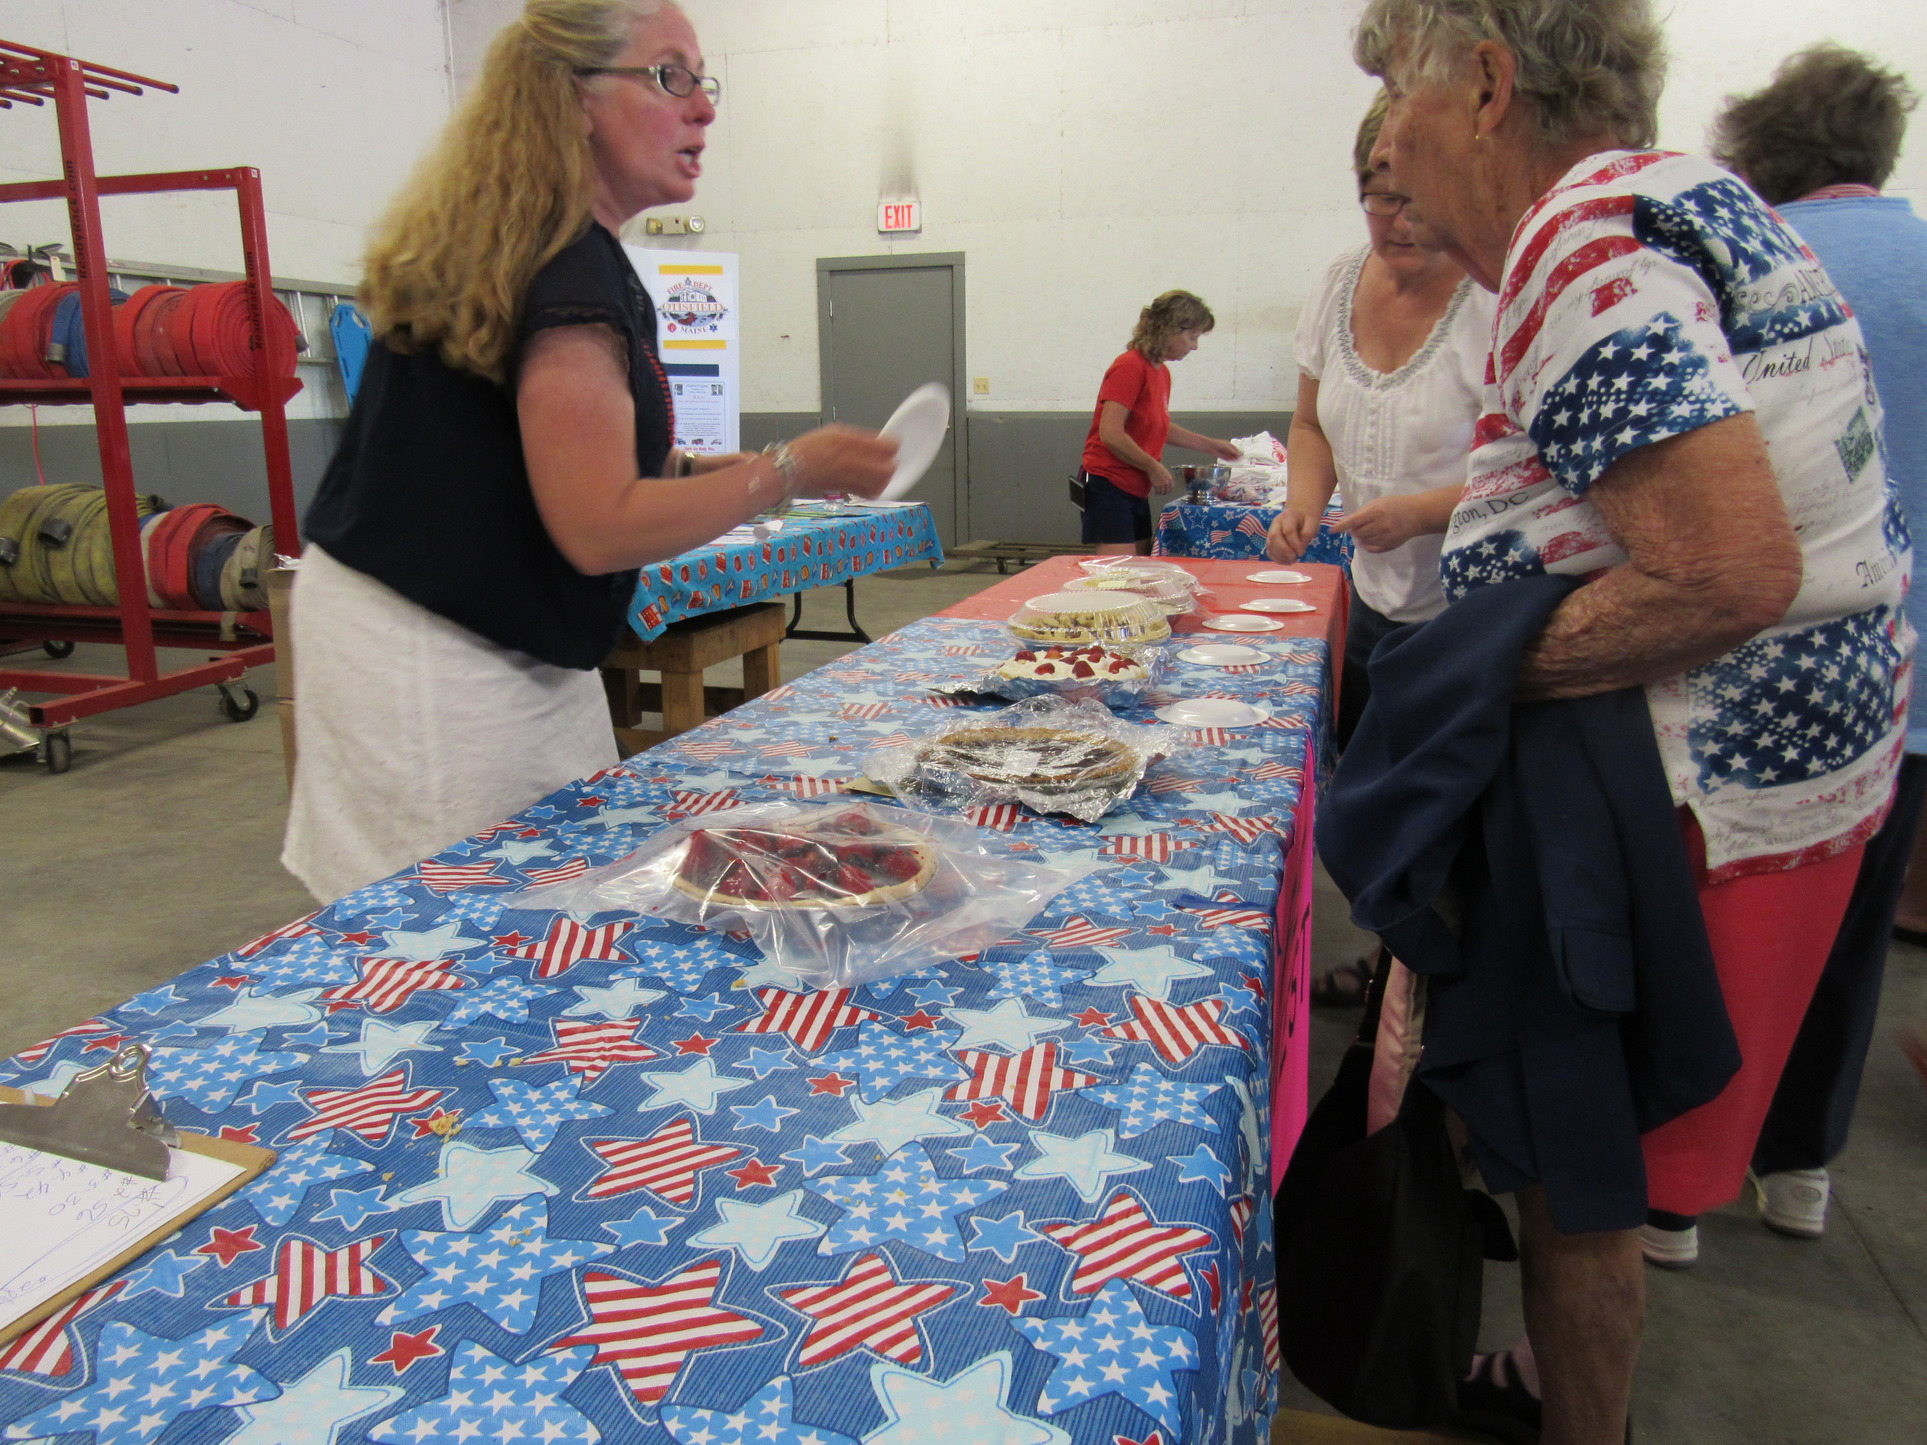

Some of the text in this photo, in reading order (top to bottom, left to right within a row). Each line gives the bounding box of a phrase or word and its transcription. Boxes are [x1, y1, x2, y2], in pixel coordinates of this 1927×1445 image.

[66, 160, 89, 279] ReadyRack.com
[884, 204, 913, 229] EXIT
[667, 281, 713, 295] FIRE DEPT
[662, 302, 724, 312] OTISFIELD
[681, 326, 708, 334] MAINE
[1742, 336, 1814, 385] United
[1484, 491, 1529, 515] DC
